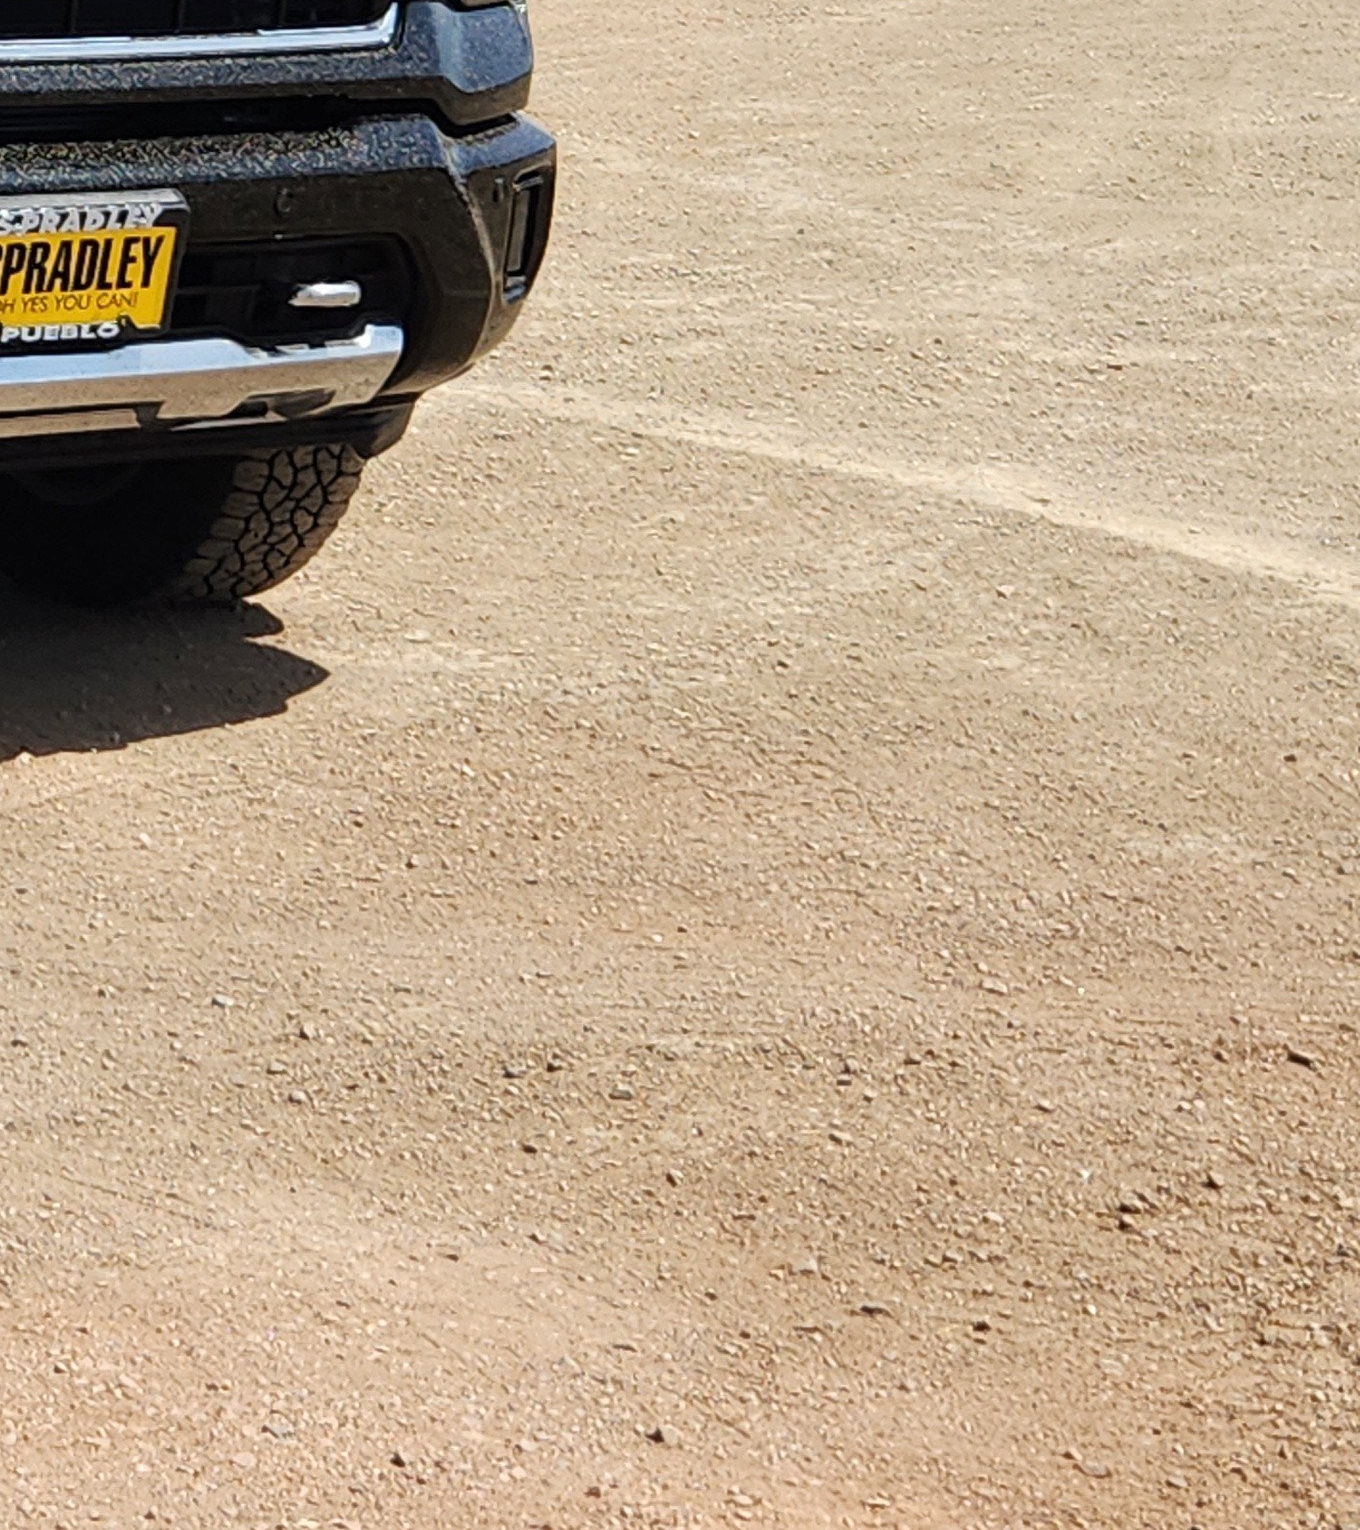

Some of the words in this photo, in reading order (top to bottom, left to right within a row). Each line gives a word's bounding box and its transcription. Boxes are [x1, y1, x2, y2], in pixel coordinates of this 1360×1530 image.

[21, 295, 50, 314] YES
[54, 293, 91, 311] YOU
[0, 322, 119, 343] PUEBLO
